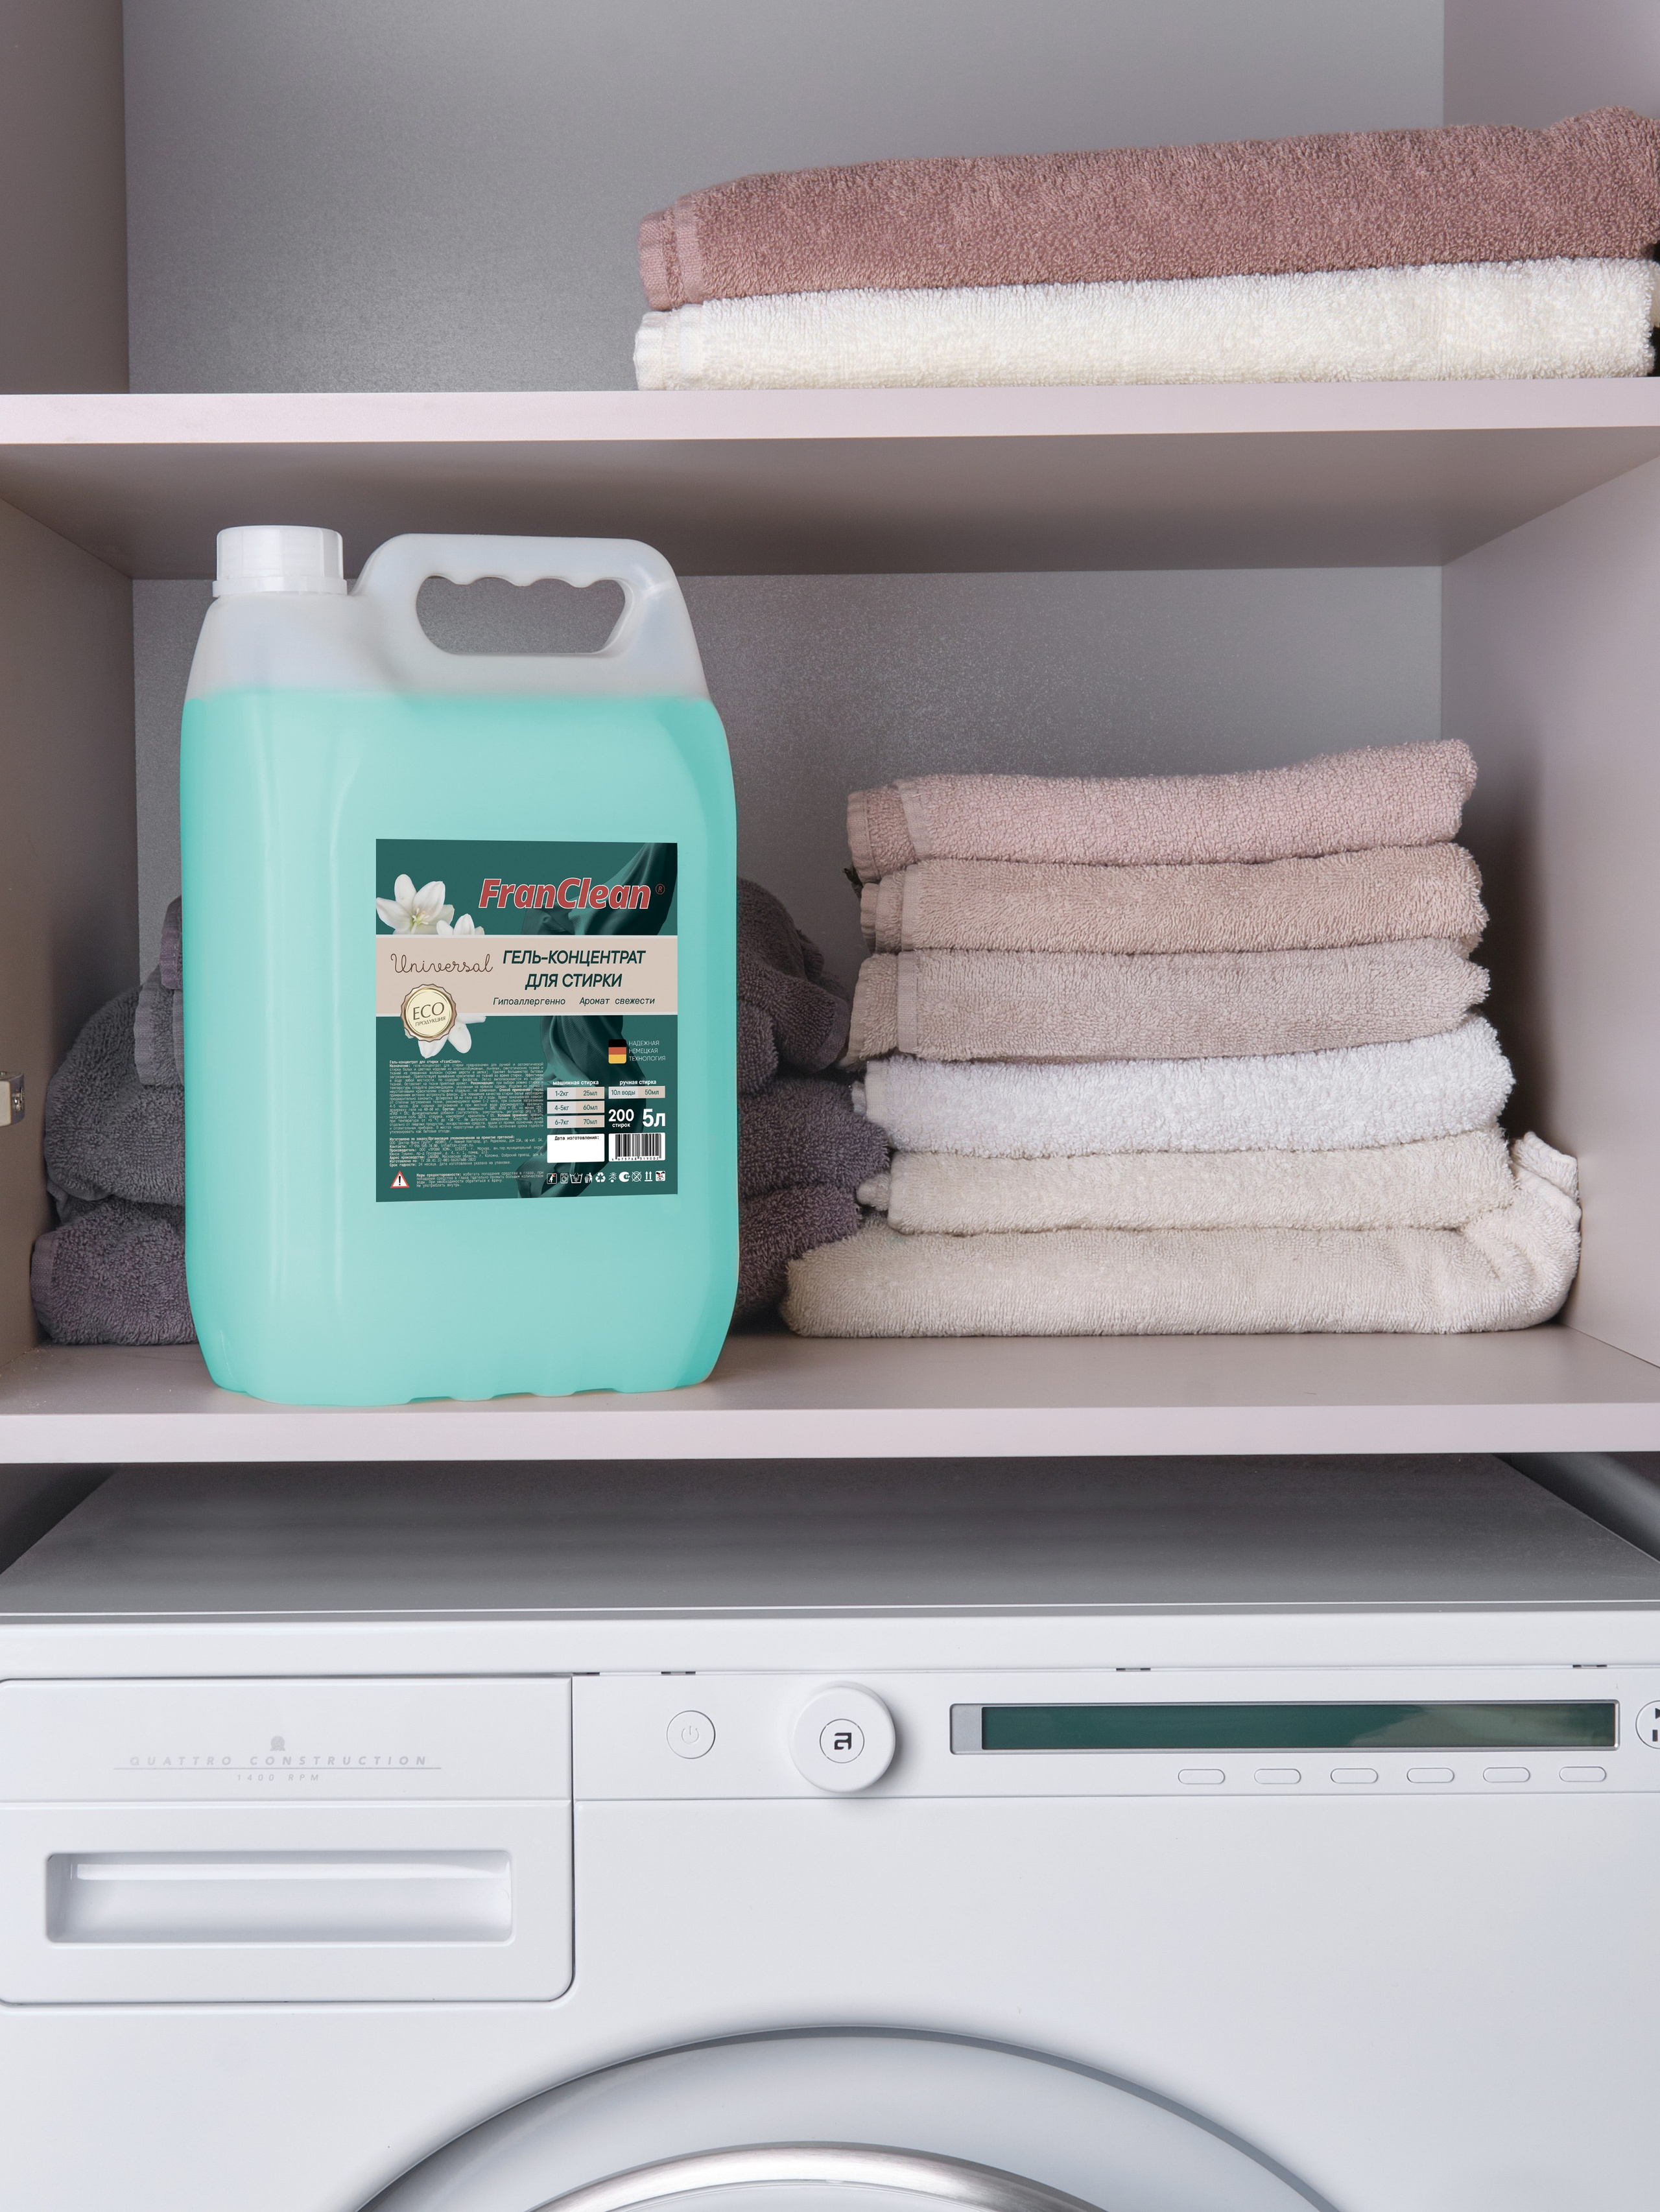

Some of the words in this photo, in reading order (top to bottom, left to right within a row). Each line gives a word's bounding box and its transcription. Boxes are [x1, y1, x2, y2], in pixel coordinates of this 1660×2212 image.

[479, 877, 651, 910] FranClean
[390, 953, 493, 973] Universal
[503, 950, 646, 967] ГЕЛЬ-КОНЦЕНТРАТ
[525, 973, 558, 990] ДЛЯ
[562, 973, 622, 987] СТИРКИ
[493, 997, 566, 1007] Гипоаллергенно
[579, 996, 610, 1006] Аромат
[412, 1002, 445, 1020] ECO
[415, 1016, 446, 1027] ПРОДУКЦИЯ
[608, 1109, 634, 1122] 200
[643, 1109, 666, 1127] 5л
[130, 1756, 232, 1766] QUATTRO
[250, 1756, 427, 1766] CONSTRUCTION
[237, 1773, 275, 1782] 1400
[288, 1773, 320, 1782] RPM
